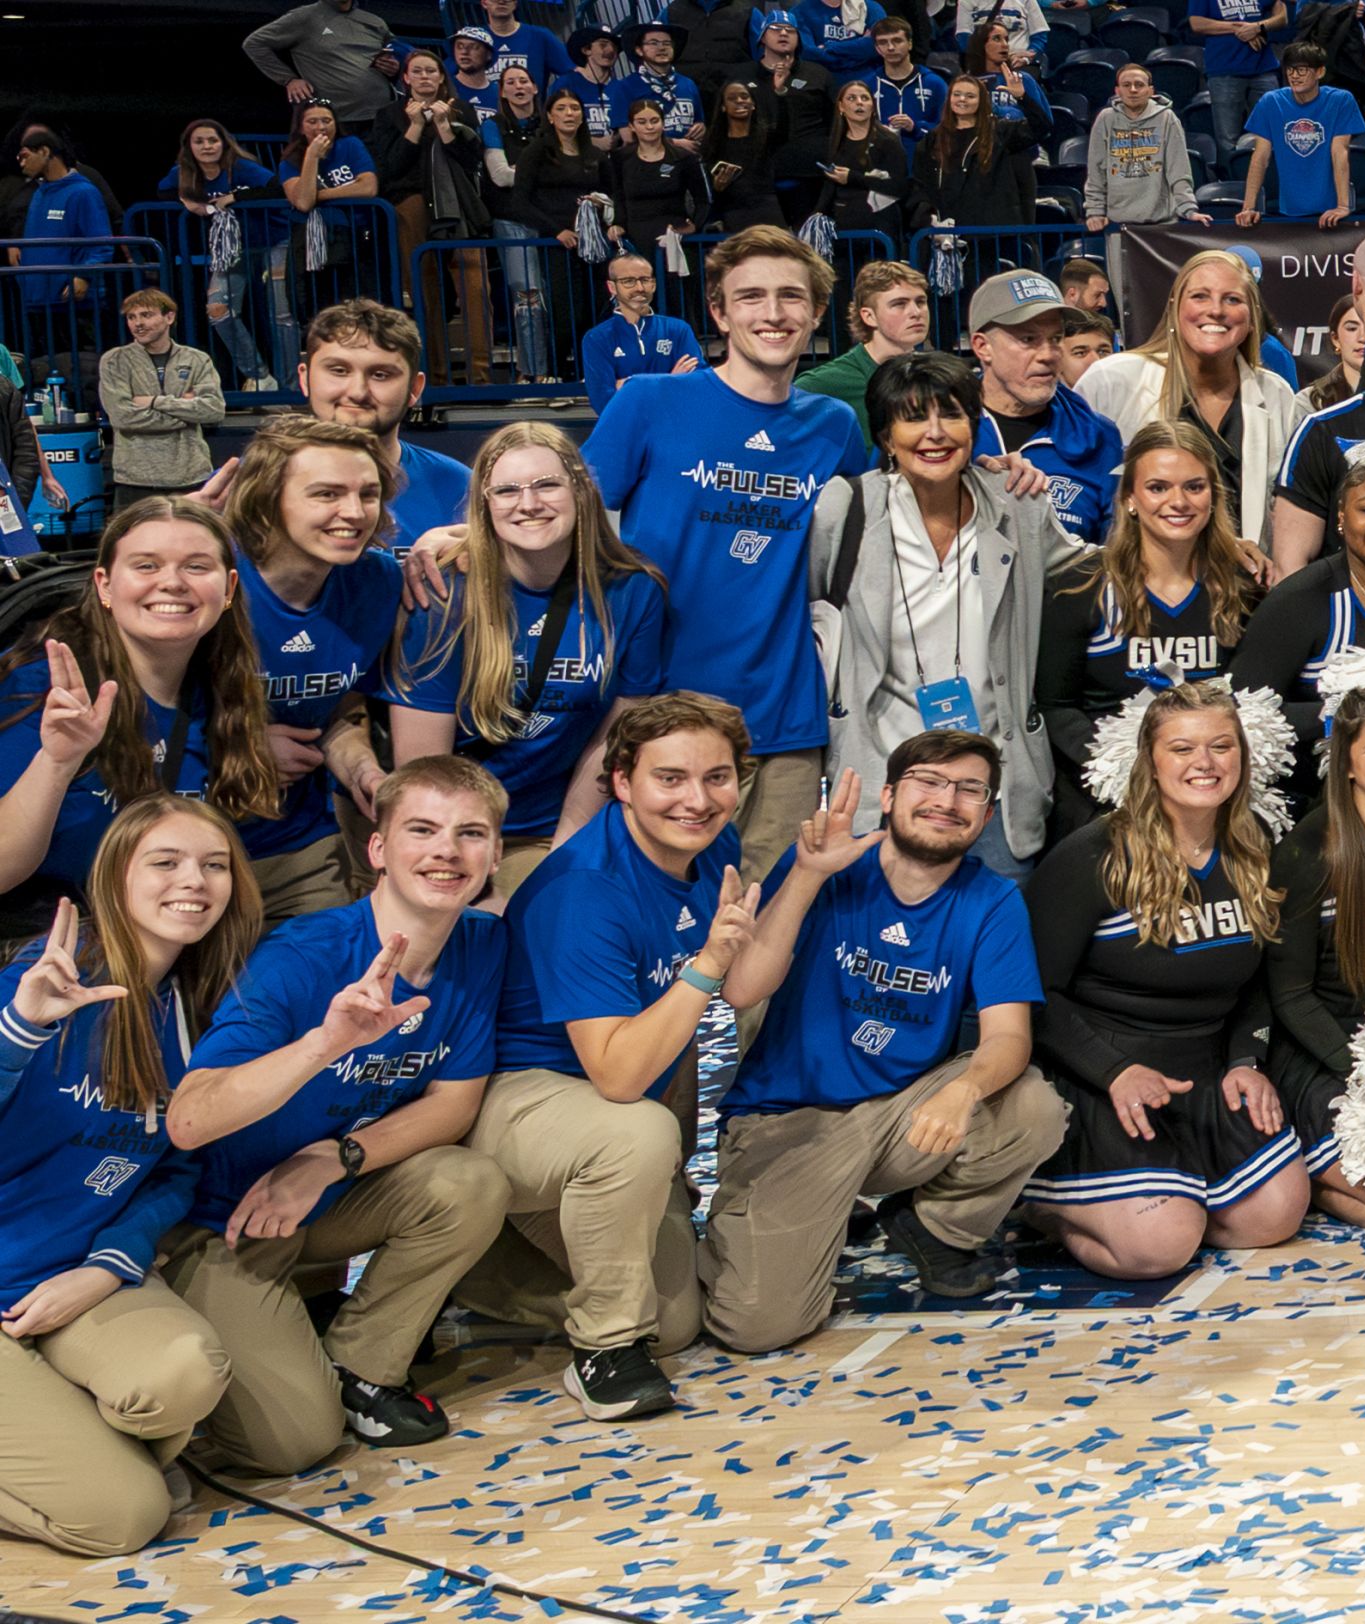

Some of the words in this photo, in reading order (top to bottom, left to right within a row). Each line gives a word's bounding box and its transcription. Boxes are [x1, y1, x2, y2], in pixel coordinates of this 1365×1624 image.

[1281, 253, 1356, 279] DIVIS
[717, 461, 734, 469] THE
[714, 467, 800, 500] PULSE
[728, 501, 781, 516] LAKER
[730, 529, 772, 564] GV
[1128, 635, 1218, 670] GVSU
[267, 671, 343, 701] ULSE
[850, 953, 932, 994] PLSE
[852, 1019, 896, 1056] GV
[368, 1053, 386, 1061] THE
[84, 1155, 141, 1197] GV
